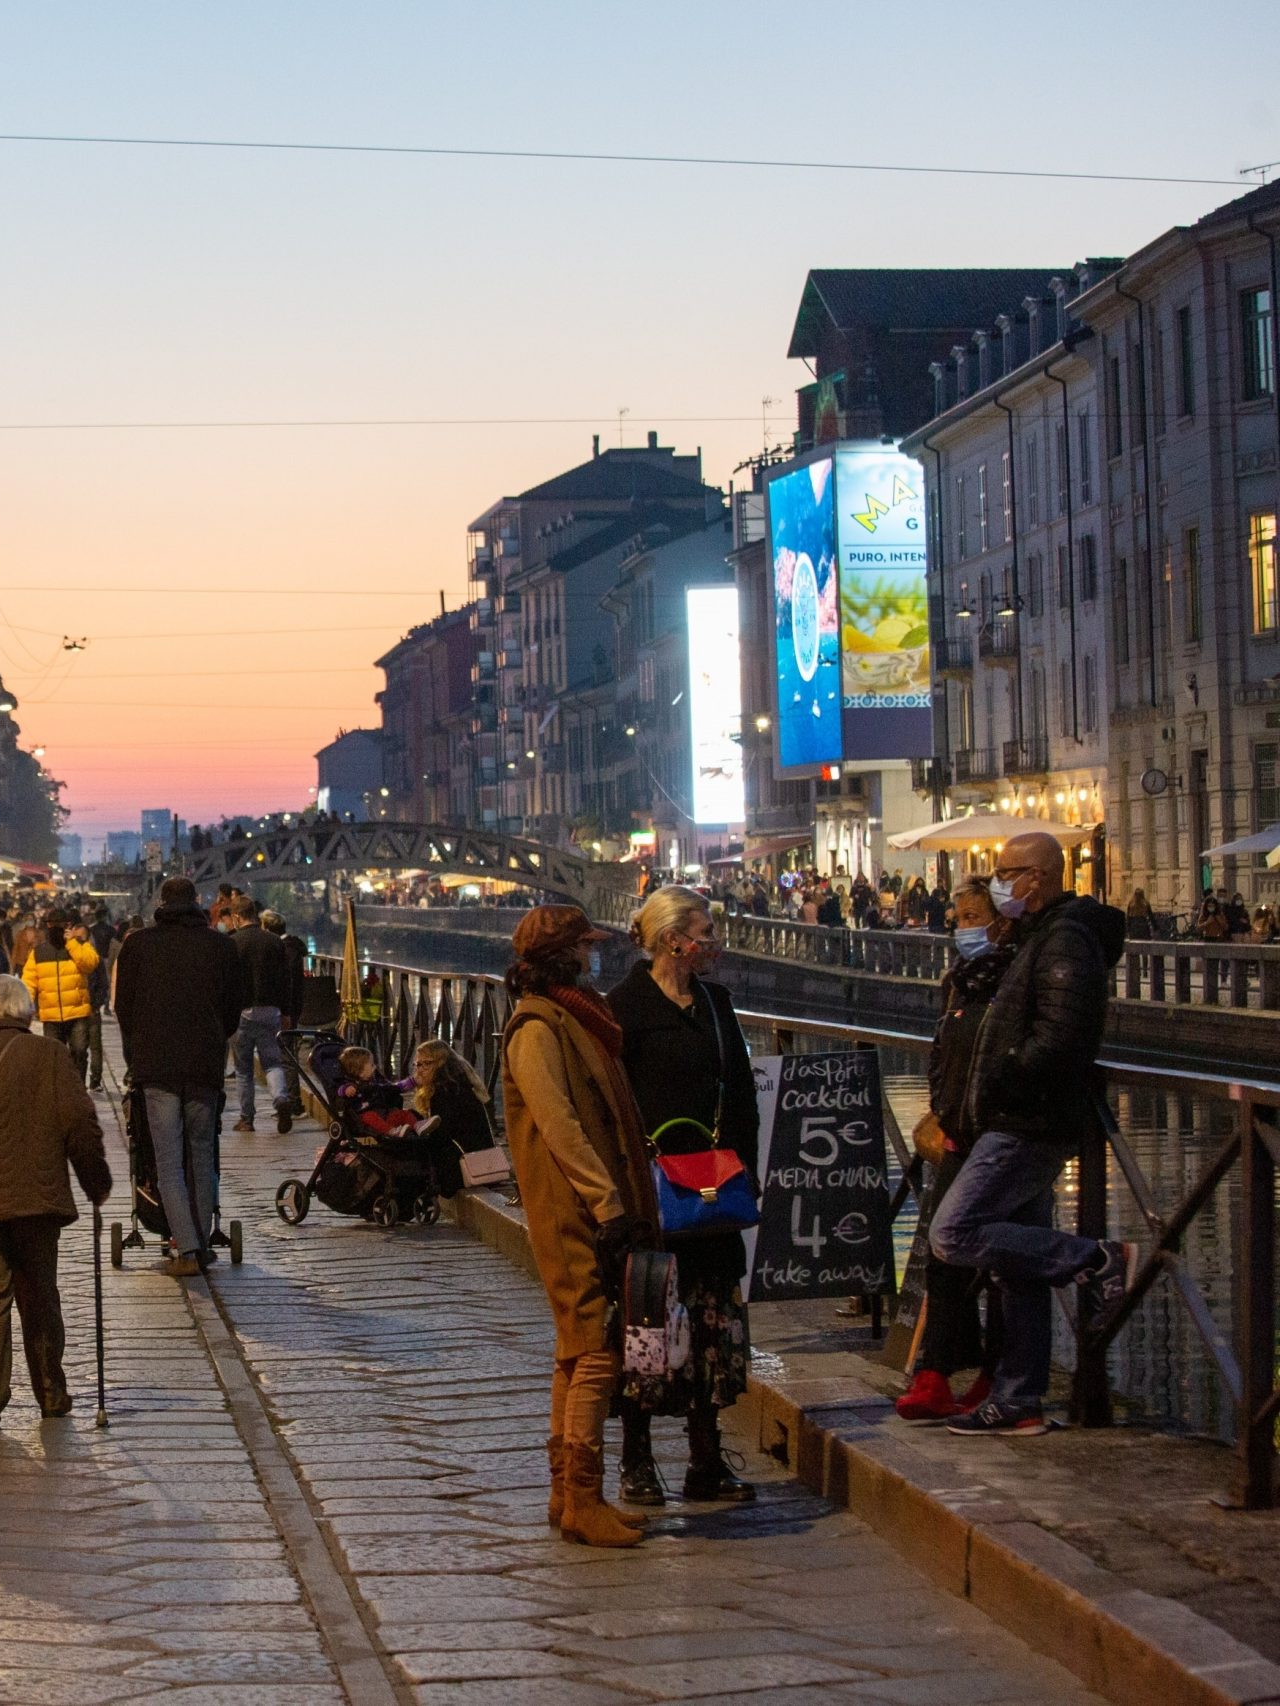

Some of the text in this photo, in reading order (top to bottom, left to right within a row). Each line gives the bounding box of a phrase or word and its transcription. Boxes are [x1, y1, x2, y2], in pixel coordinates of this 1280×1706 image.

[849, 552, 927, 563] PURO, INTEN
[767, 1167, 822, 1190] MEDIA
[757, 1258, 886, 1293] take away
